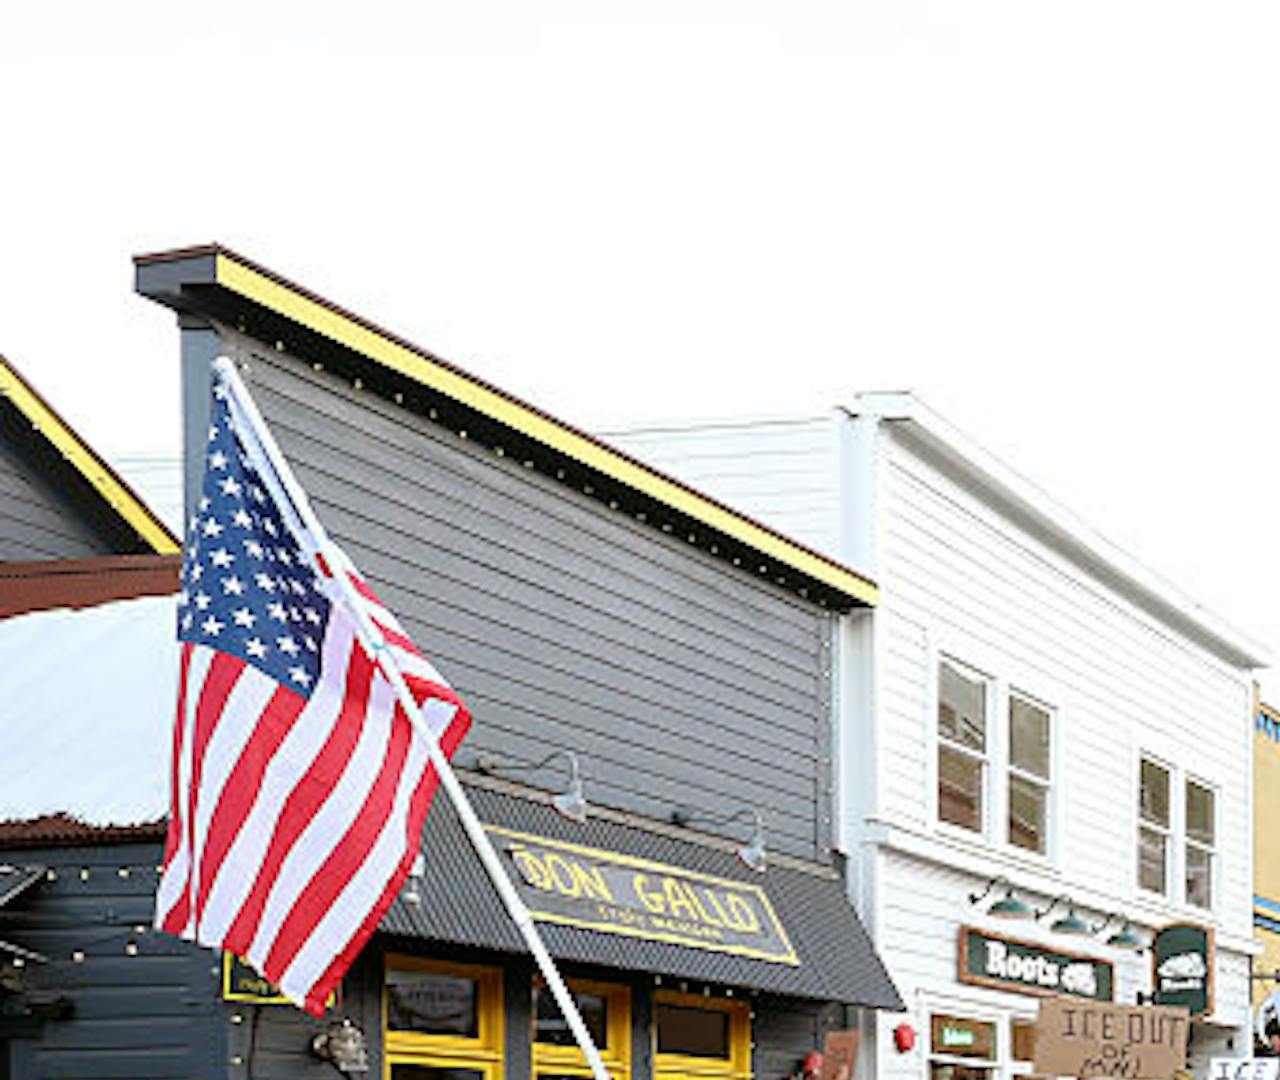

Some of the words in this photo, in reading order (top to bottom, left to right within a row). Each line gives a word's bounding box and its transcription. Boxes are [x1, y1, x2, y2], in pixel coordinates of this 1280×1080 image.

[515, 850, 613, 902] DON
[633, 874, 761, 933] GALLO
[985, 941, 1059, 985] Roots
[1063, 1010, 1117, 1041] ICE
[1128, 1010, 1187, 1046] OUT
